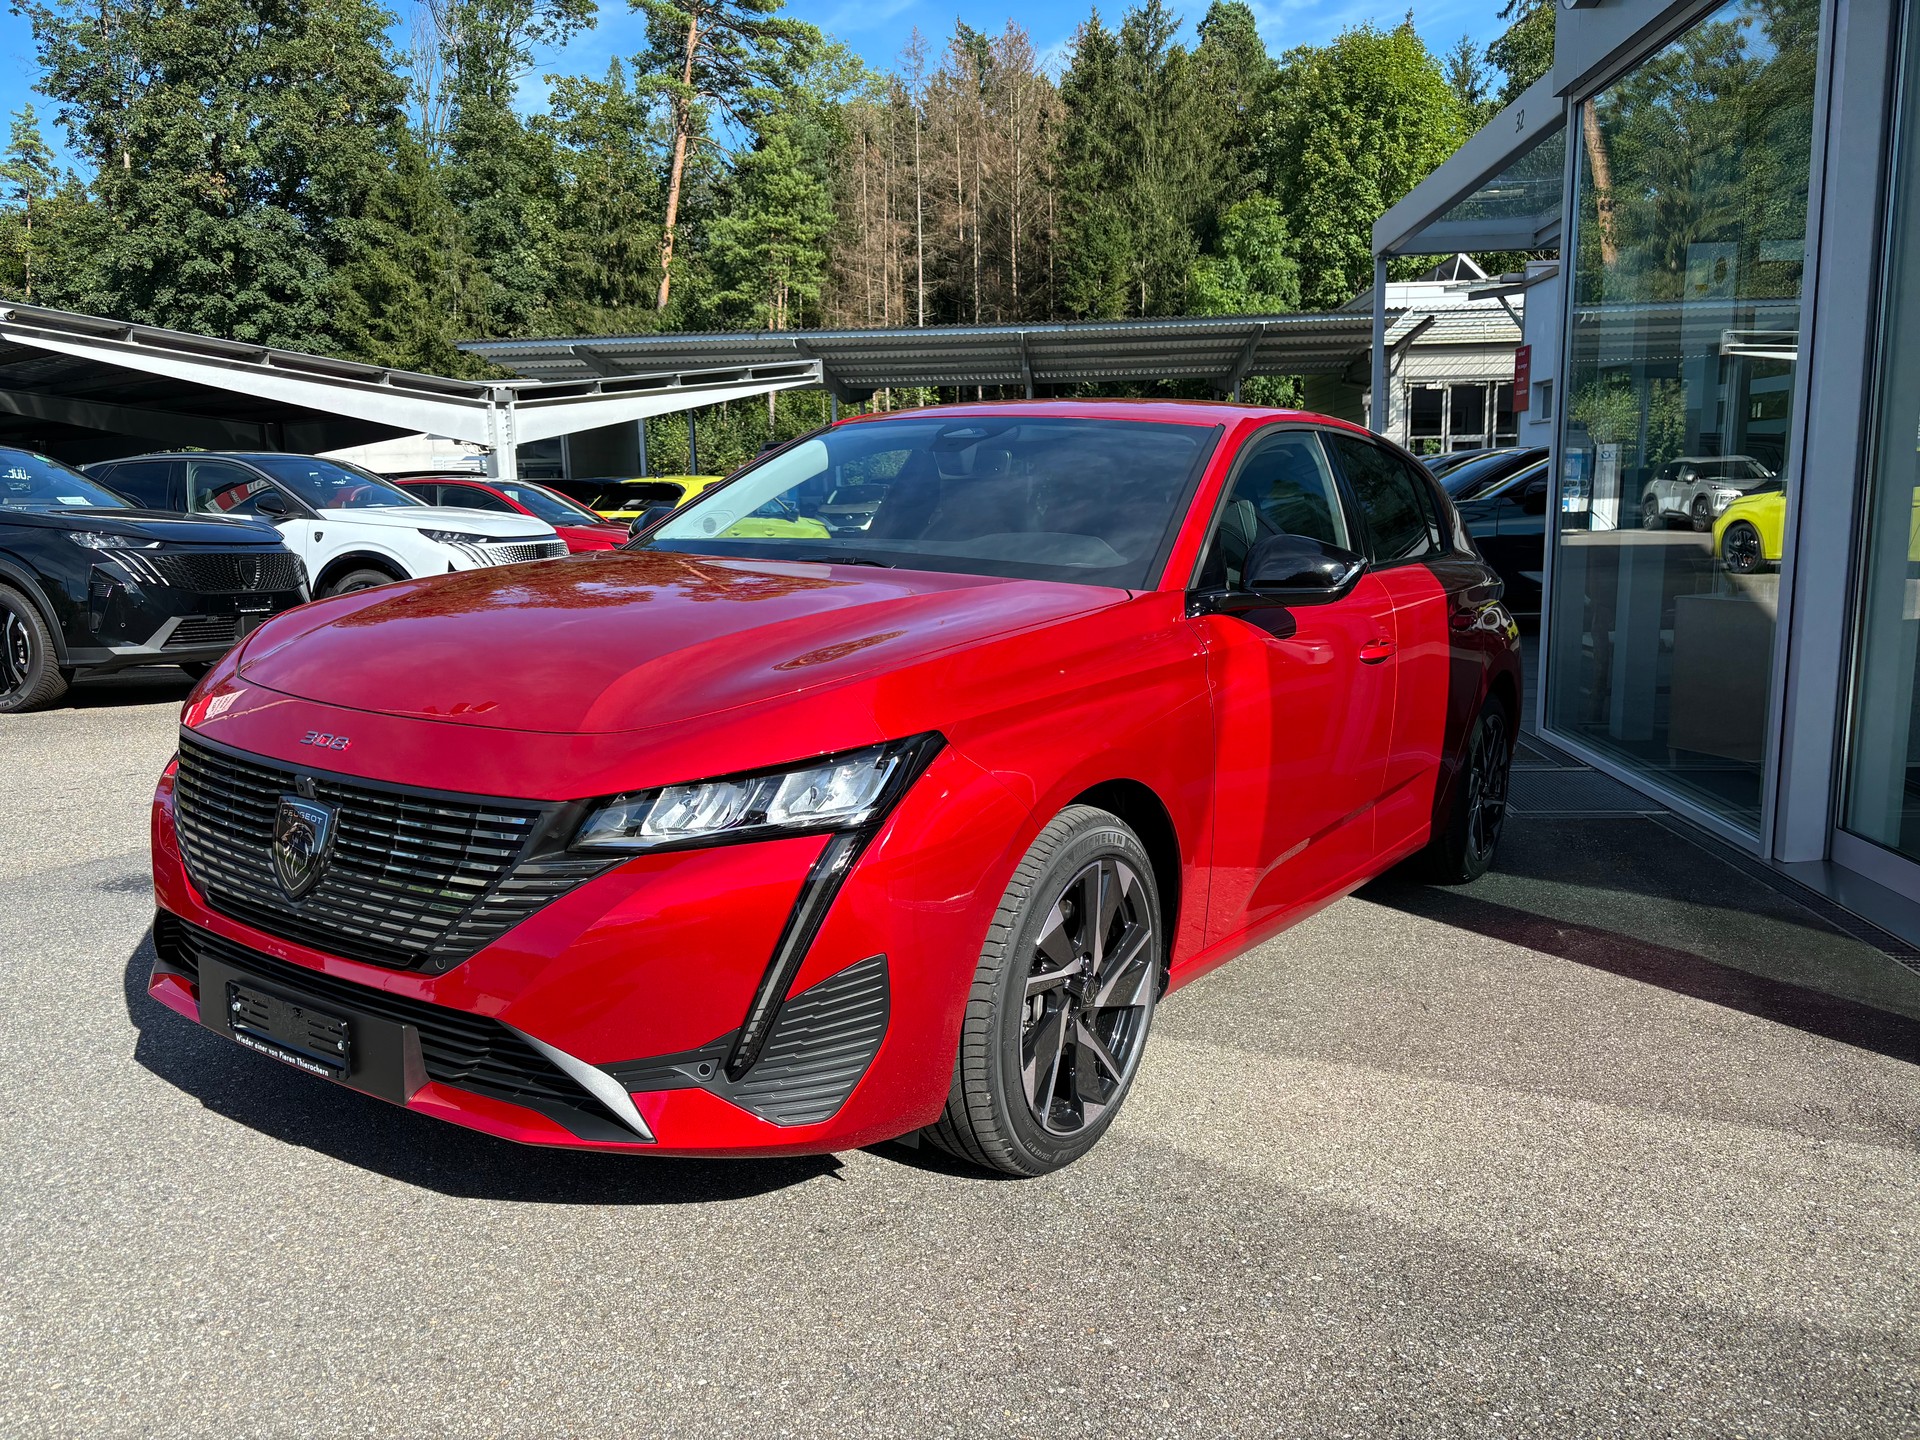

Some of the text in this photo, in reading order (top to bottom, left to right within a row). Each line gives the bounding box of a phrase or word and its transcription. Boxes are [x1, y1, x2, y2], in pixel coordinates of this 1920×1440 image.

[1515, 108, 1525, 133] 32
[299, 730, 350, 751] 308
[283, 808, 323, 825] PEUGEOT
[1074, 832, 1124, 857] MICHELIN
[235, 1033, 254, 1047] Wieder
[254, 1042, 268, 1053] einer
[268, 1048, 278, 1057] von
